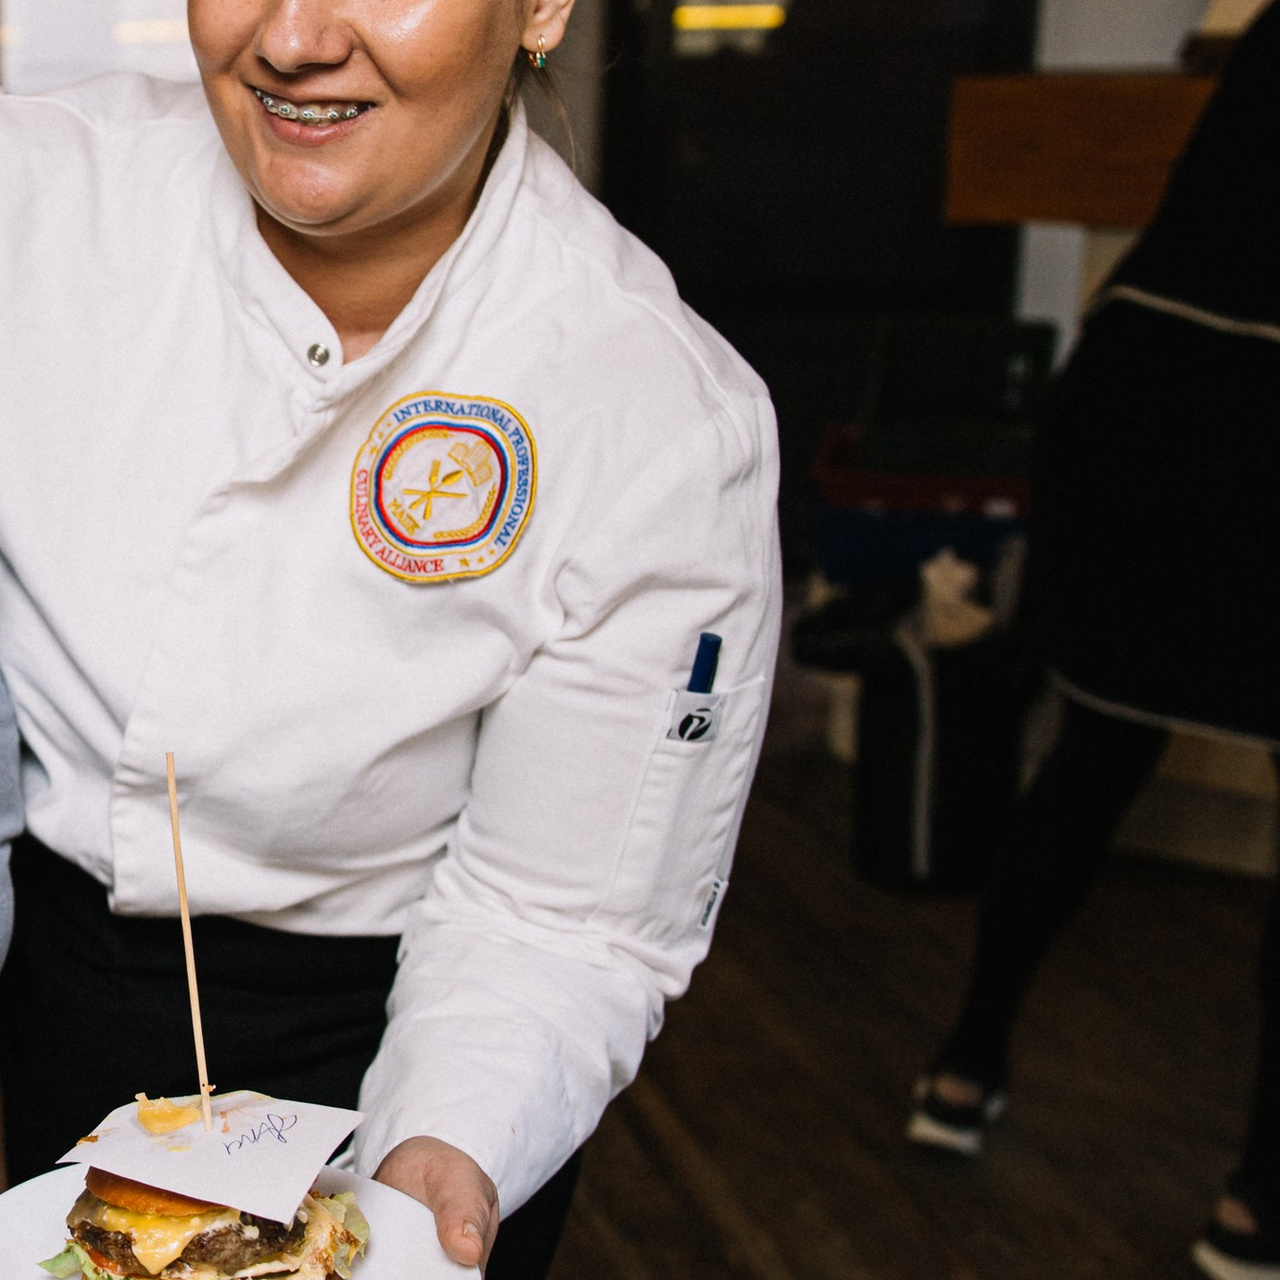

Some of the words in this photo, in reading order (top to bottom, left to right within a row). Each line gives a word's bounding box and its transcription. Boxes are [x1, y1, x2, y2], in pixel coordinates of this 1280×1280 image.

[355, 469, 381, 549] CULINARY
[375, 547, 444, 574] ALLIANCE
[392, 399, 512, 432] INTERNATIONAL
[494, 426, 530, 548] PROFESSIONAL
